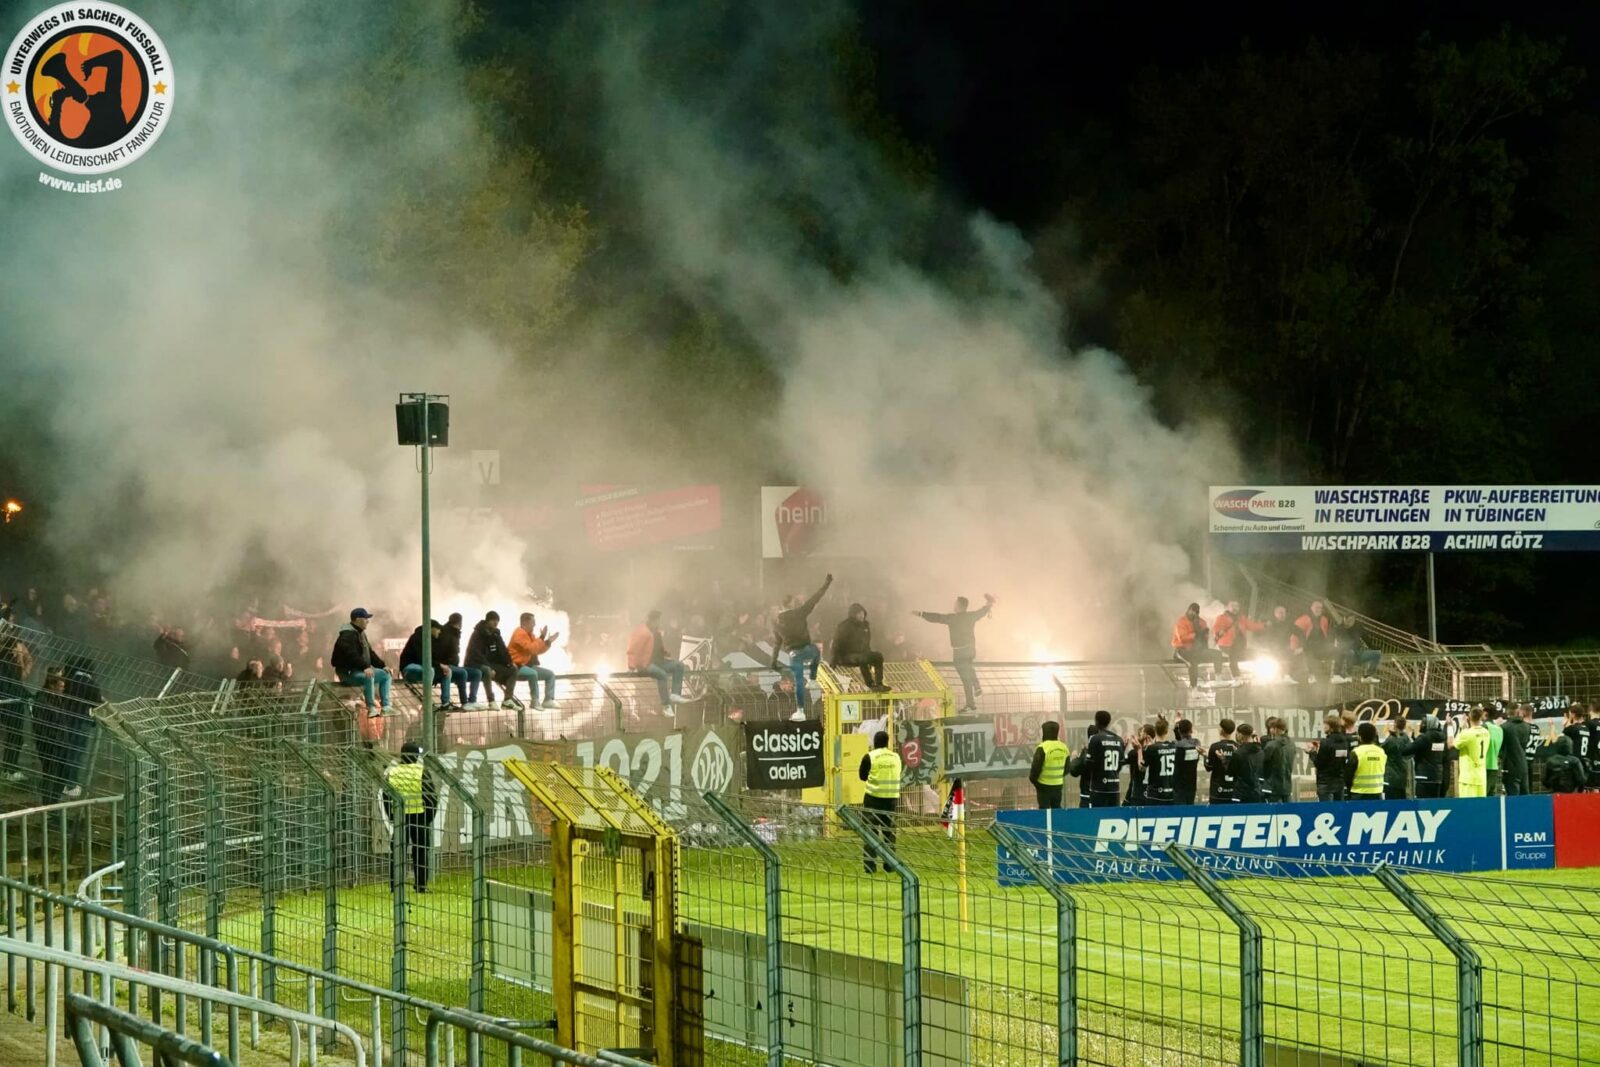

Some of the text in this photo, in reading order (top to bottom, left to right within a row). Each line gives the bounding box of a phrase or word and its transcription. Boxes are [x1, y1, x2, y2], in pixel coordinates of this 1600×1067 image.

[1214, 499, 1296, 509] WASCH PARK B28
[1315, 489, 1430, 506] WASCHSTRAßE
[1444, 489, 1600, 504] PKW-AUFBEREITUN
[1315, 508, 1430, 523] IN REUTLINGEN
[1444, 503, 1546, 522] IN TÜBINGEN
[1302, 535, 1430, 550] WASCHPARK B28
[1444, 530, 1543, 549] ACHIM GÖTZ
[752, 727, 820, 752] classics
[1479, 739, 1486, 759] 1
[1580, 736, 1590, 757] 8
[1103, 750, 1120, 771] 20
[1159, 754, 1176, 777] 15
[769, 762, 807, 780] aalen
[1094, 809, 1452, 853] PFEIFFER & MAY
[1514, 831, 1546, 842] P&M
[1303, 849, 1447, 868] HAUSTECHNIK
[1514, 851, 1547, 861] Gruppe
